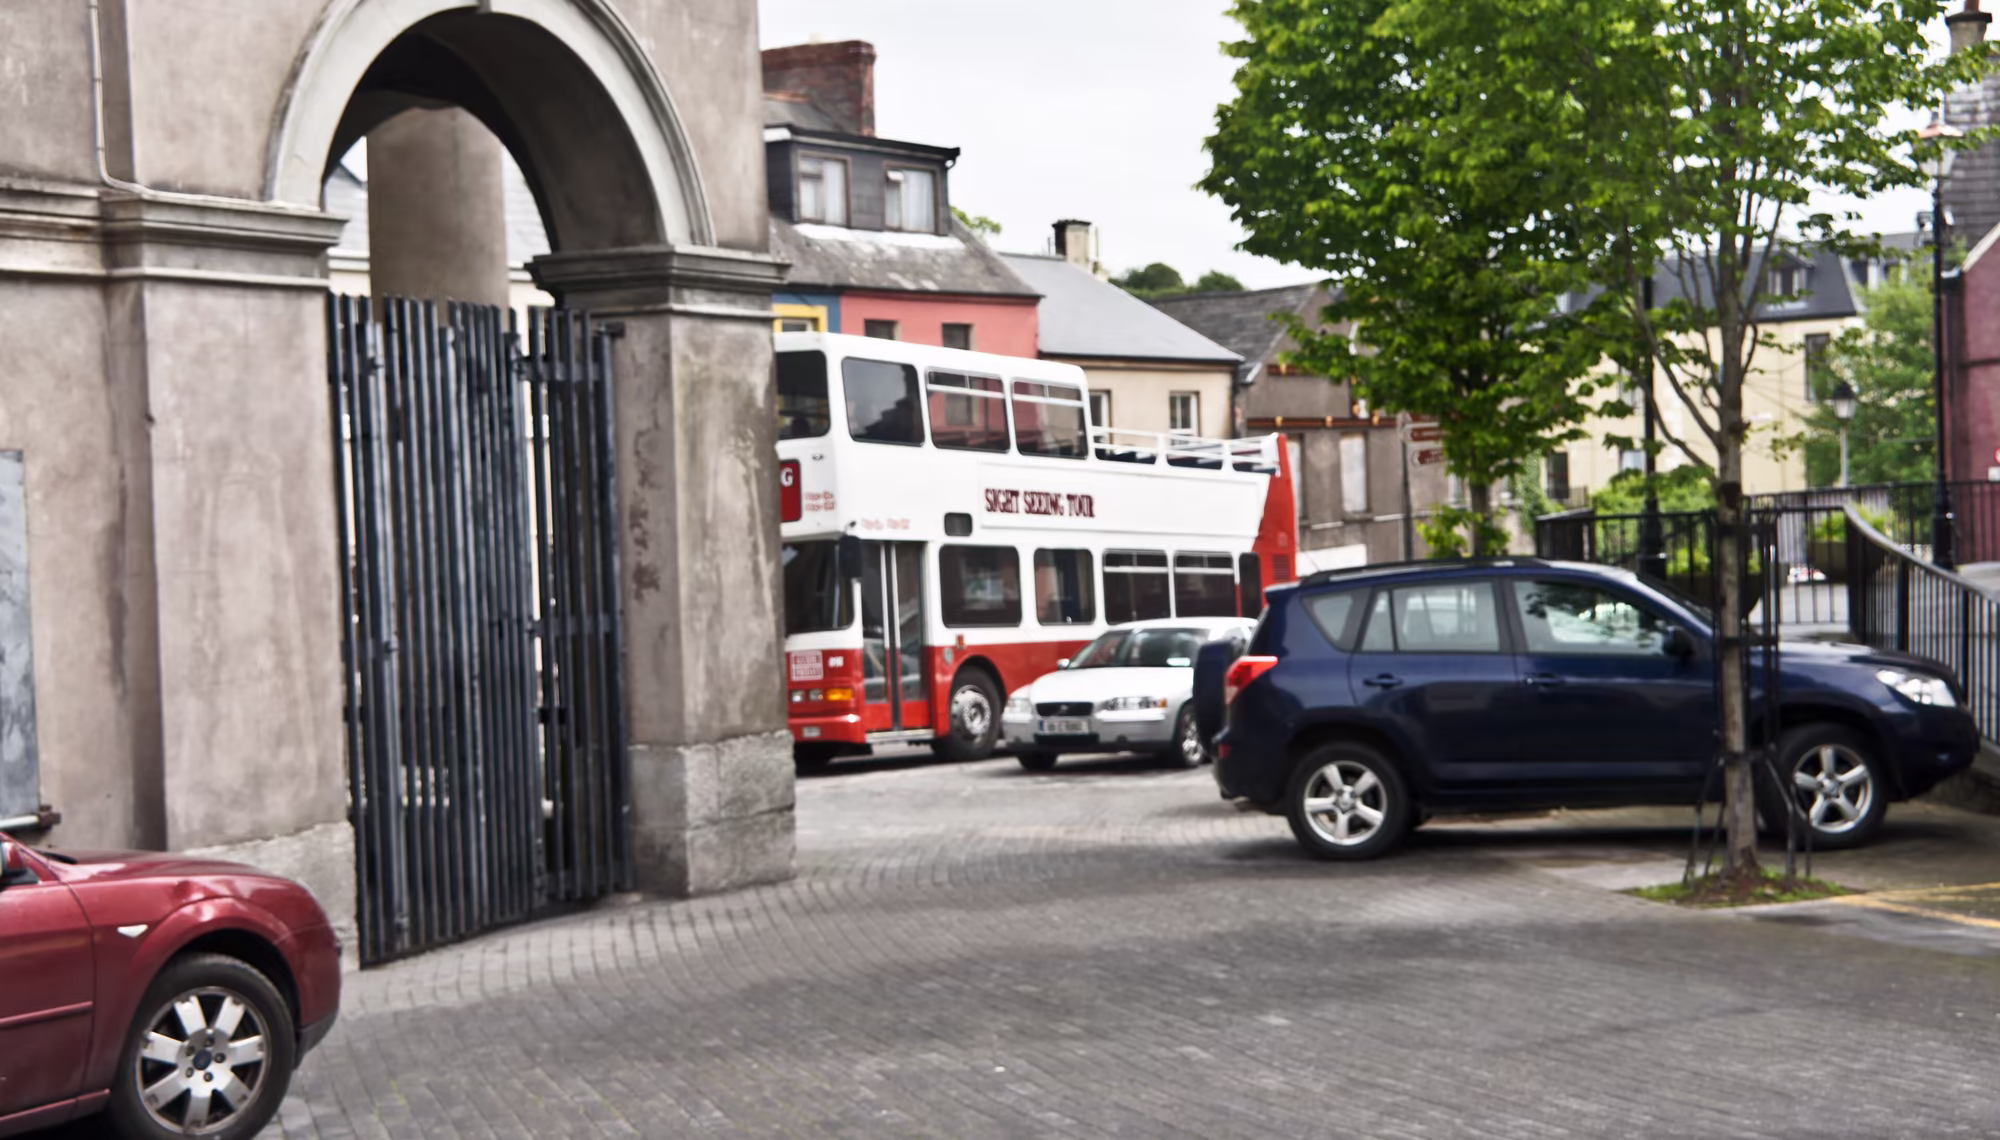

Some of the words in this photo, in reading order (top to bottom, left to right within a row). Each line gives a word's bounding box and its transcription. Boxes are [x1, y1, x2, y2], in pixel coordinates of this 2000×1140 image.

[985, 488, 1019, 513] SIGHT
[1023, 491, 1064, 516] SEEING
[1066, 493, 1095, 518] TOUR
